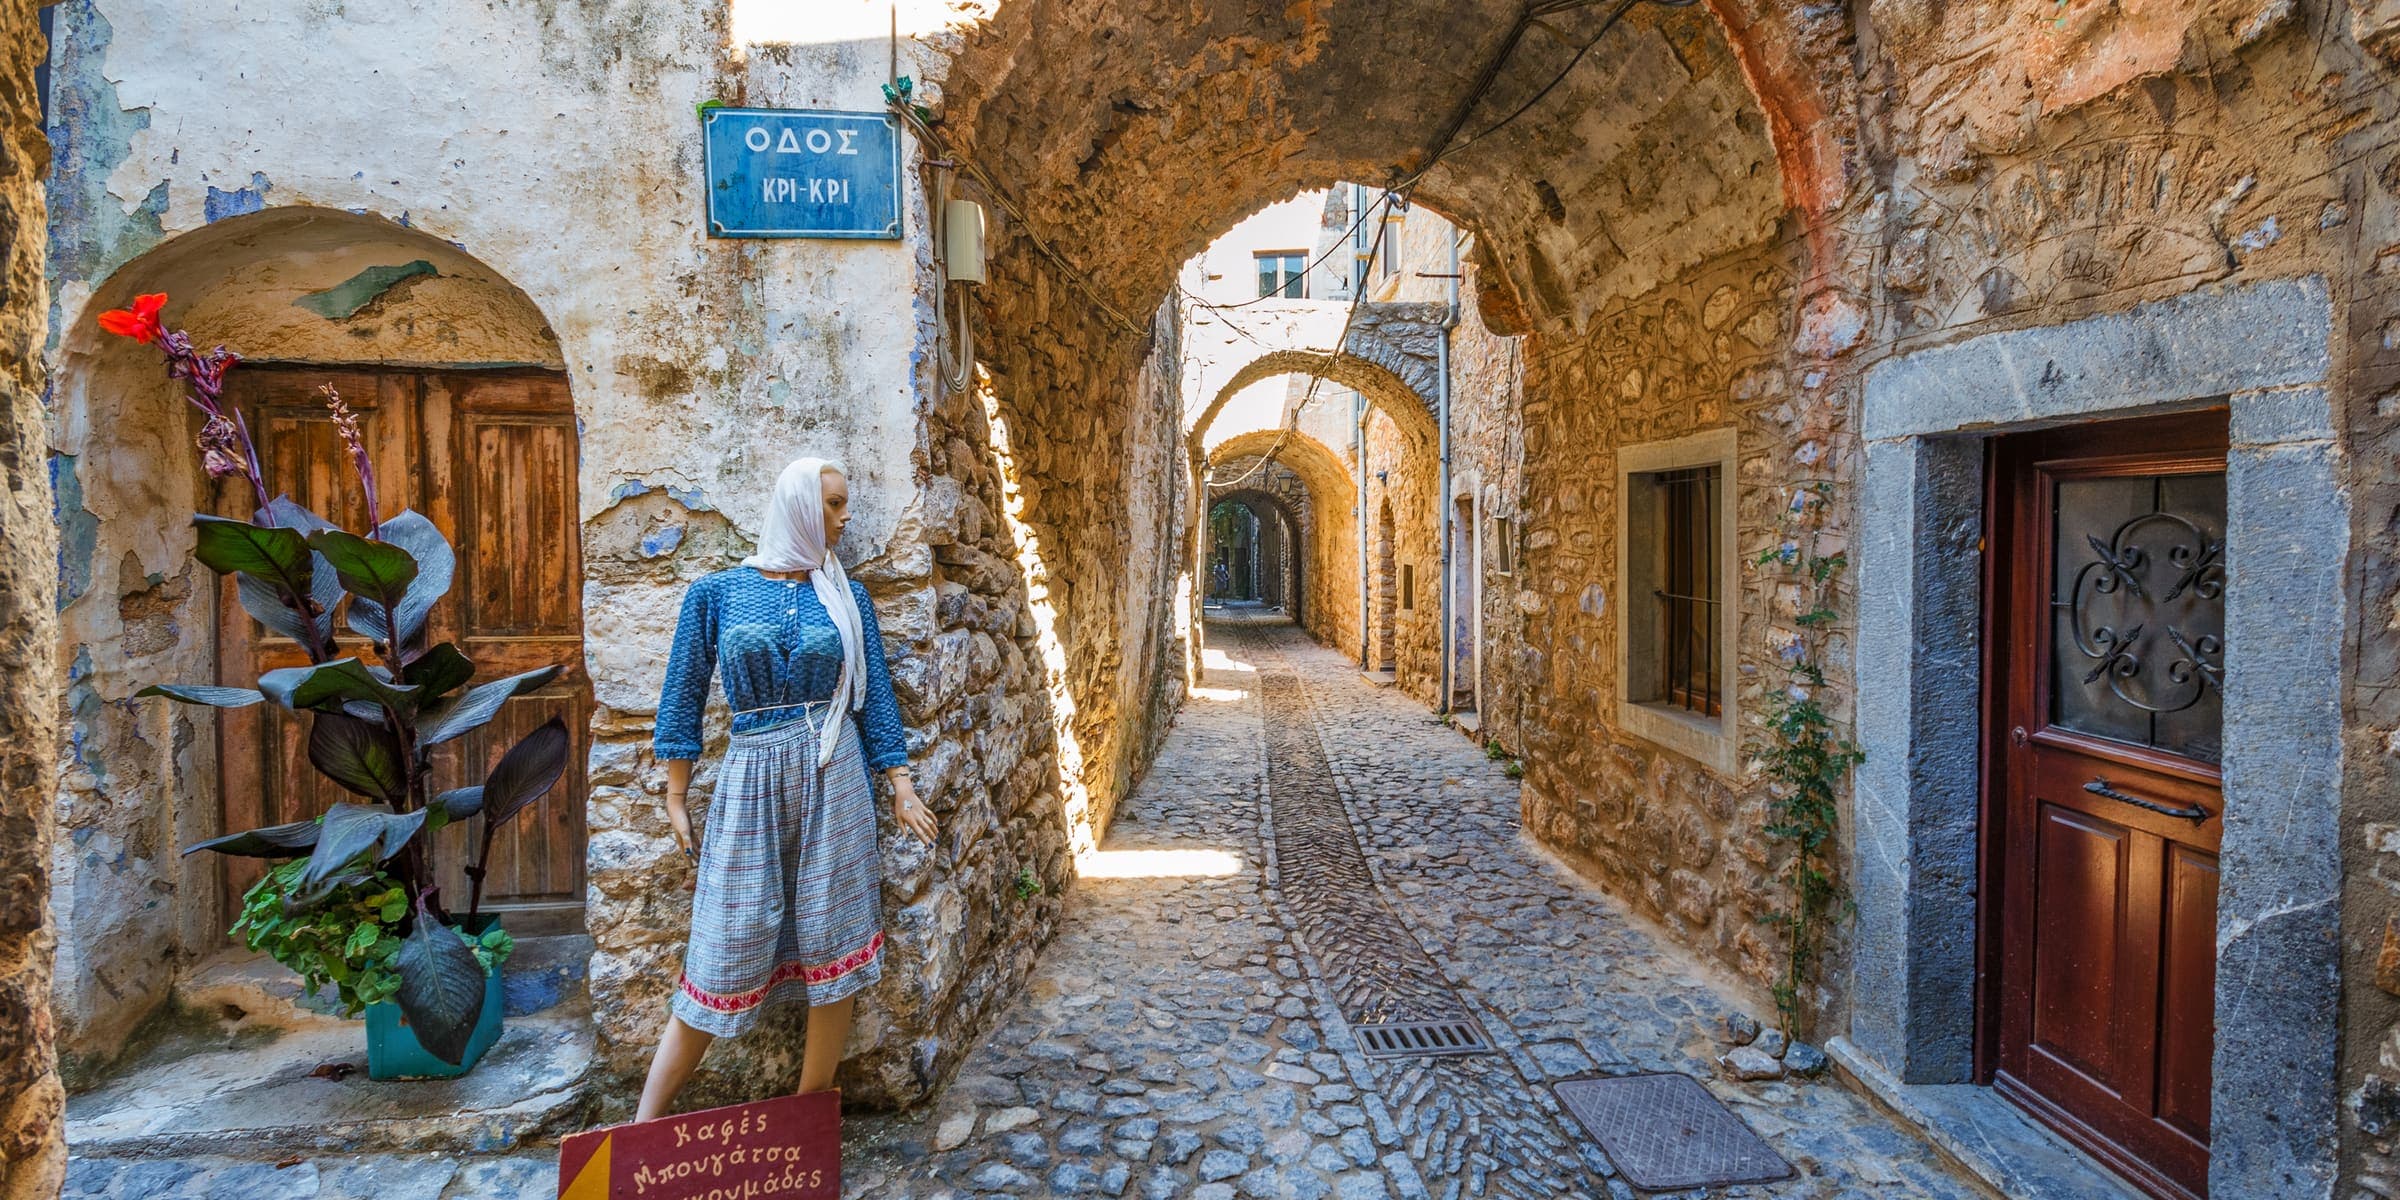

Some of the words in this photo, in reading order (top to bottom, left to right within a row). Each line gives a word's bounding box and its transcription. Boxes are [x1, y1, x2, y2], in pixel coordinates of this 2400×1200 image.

[745, 127, 858, 155] ΟΔΟΣ
[763, 178, 849, 204] ΚΡΙ-ΚΡΙ
[673, 1110, 768, 1148] Καφές
[633, 1144, 801, 1194] Μπουγάτσα
[682, 1164, 822, 1200] ουμάδες
